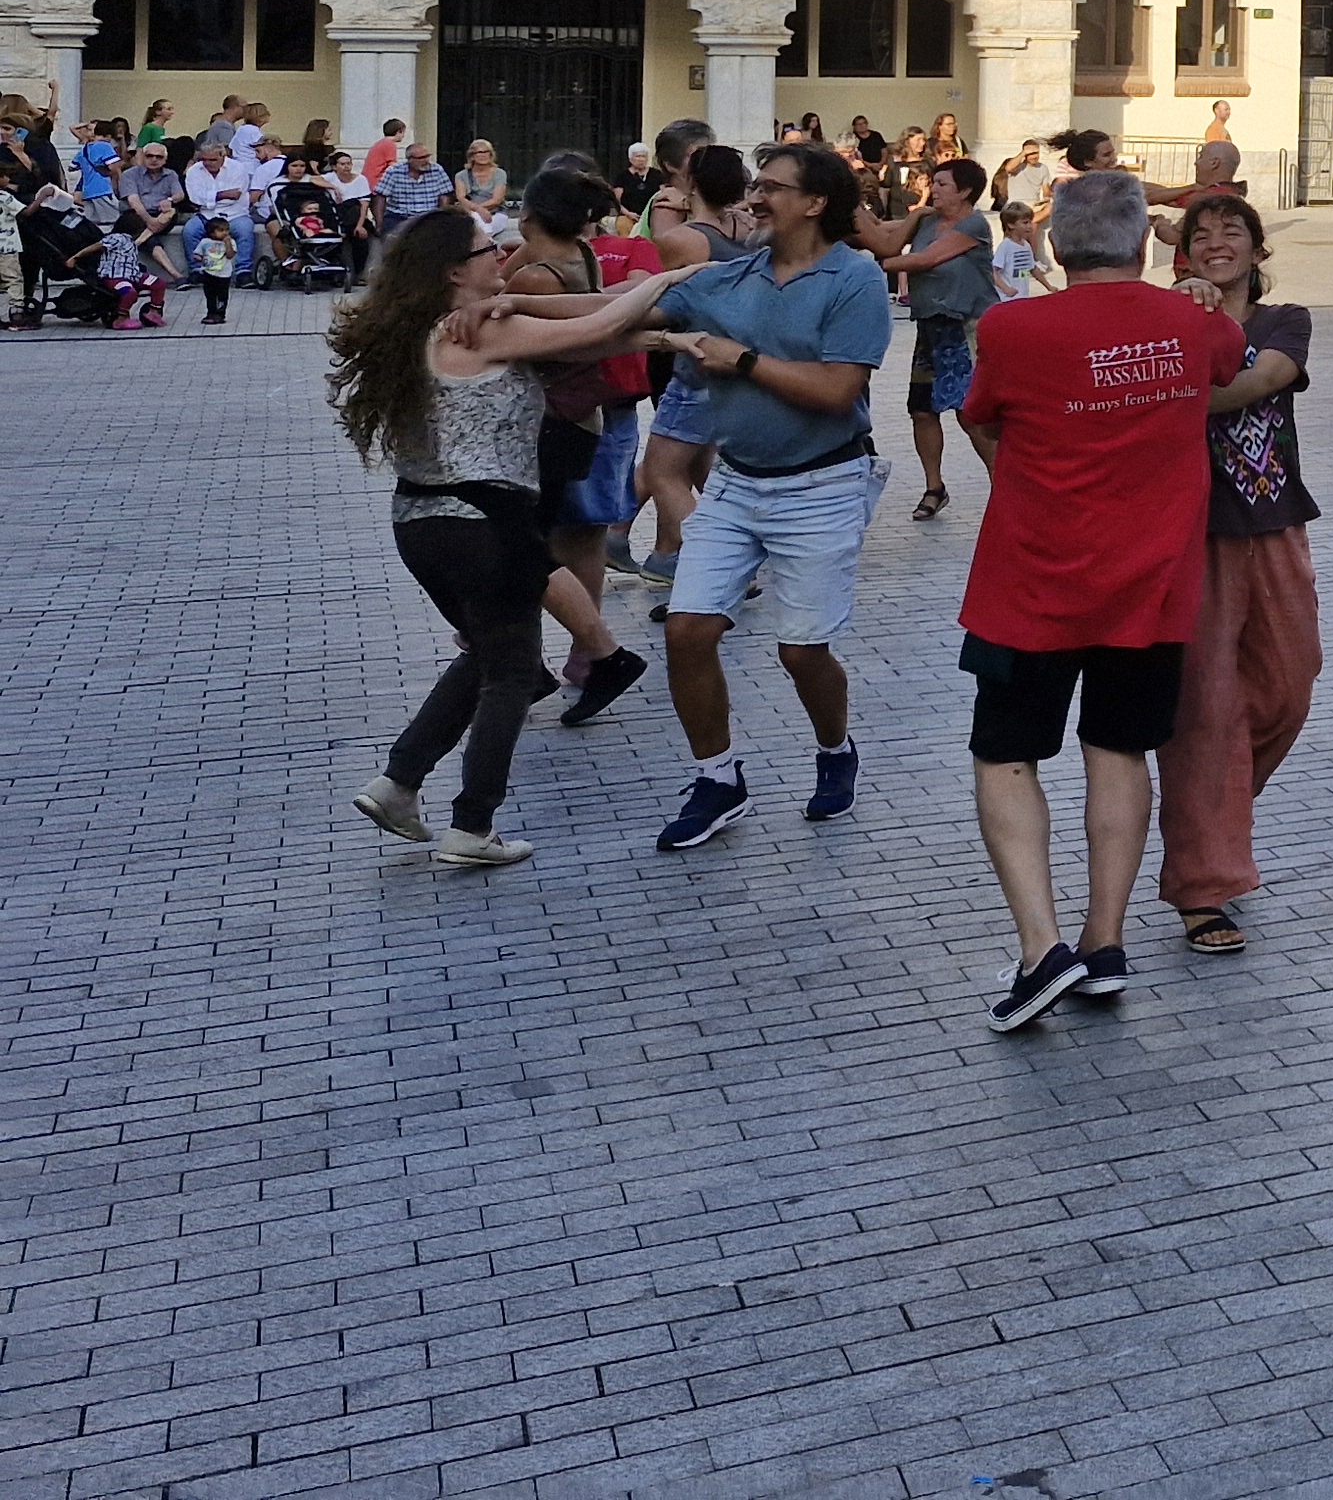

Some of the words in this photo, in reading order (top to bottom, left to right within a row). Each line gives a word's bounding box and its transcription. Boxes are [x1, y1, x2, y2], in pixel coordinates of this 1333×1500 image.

[1064, 400, 1084, 415] 30
[1088, 399, 1120, 414] anys
[1125, 389, 1168, 407] fent-la
